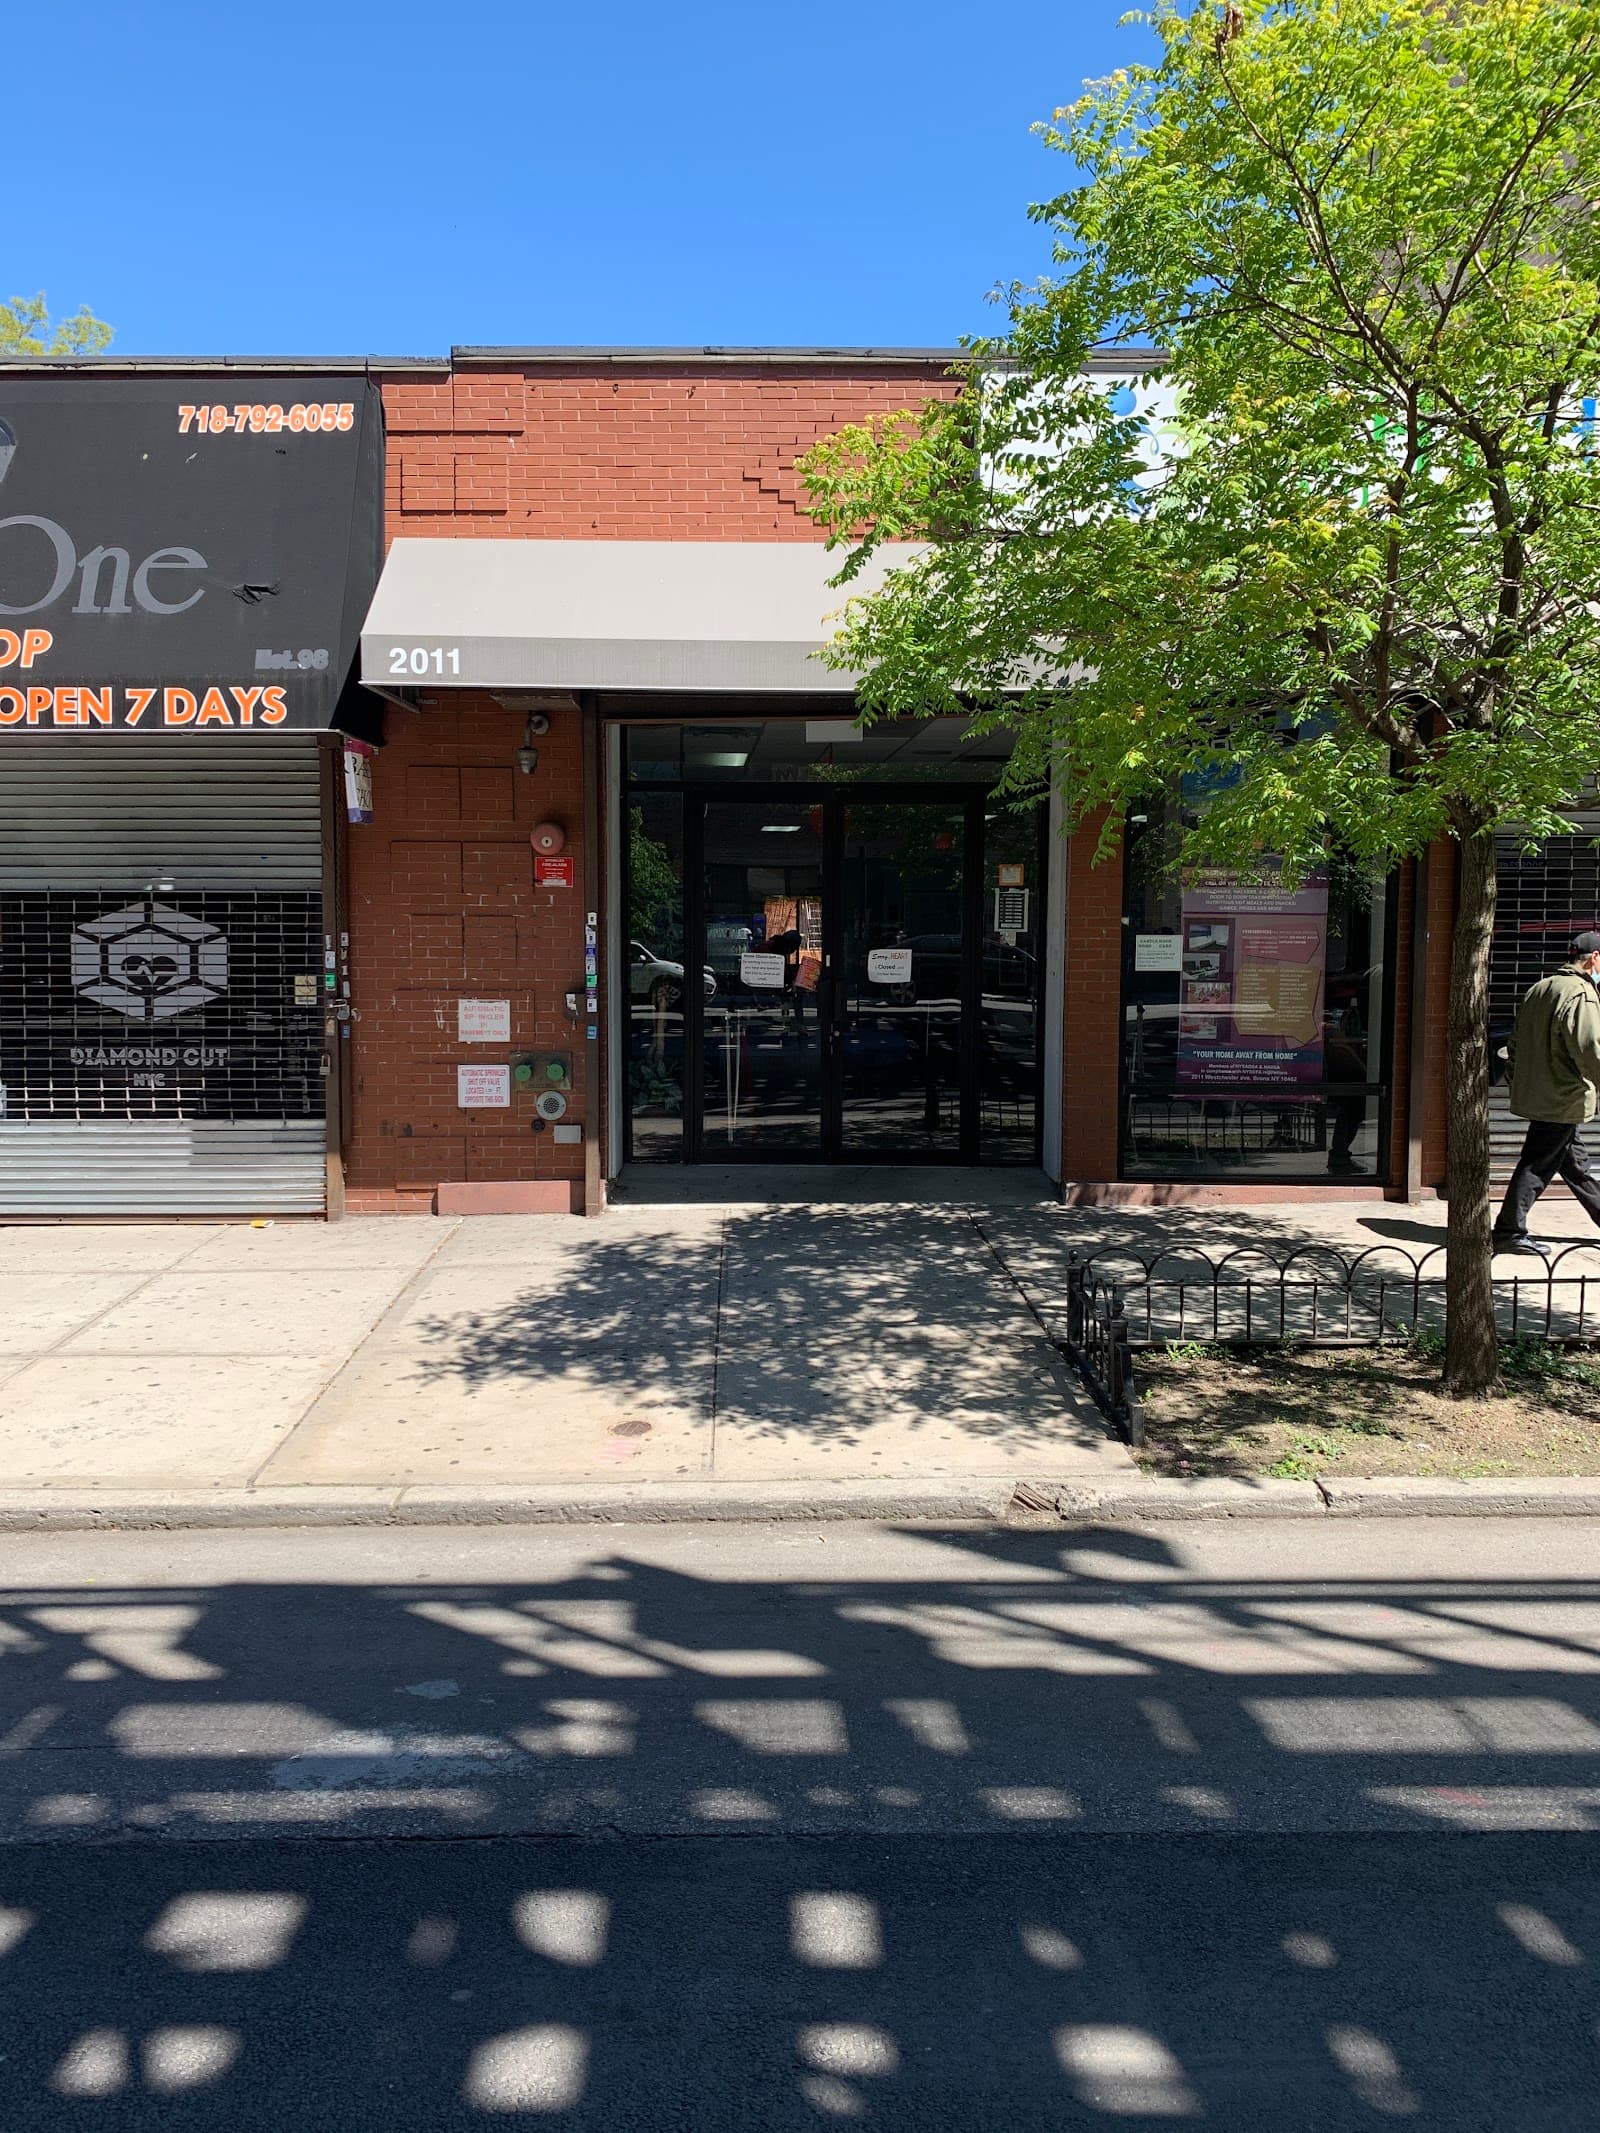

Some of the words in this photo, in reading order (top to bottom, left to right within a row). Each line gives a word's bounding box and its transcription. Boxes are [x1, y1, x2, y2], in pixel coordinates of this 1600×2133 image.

[178, 403, 354, 434] 718-792-6055
[0, 515, 208, 614] One
[389, 647, 460, 674] 2011
[0, 687, 112, 725] OPEN
[125, 688, 158, 726] 7
[164, 686, 287, 725] DAYS
[890, 952, 908, 960] HEART
[70, 1048, 178, 1066] DIAMOND
[183, 1048, 228, 1066] CUT
[1215, 1050, 1234, 1059] HOME
[1235, 1051, 1254, 1059] AWAY
[1255, 1051, 1273, 1060] FROM
[133, 1073, 166, 1087] NYC
